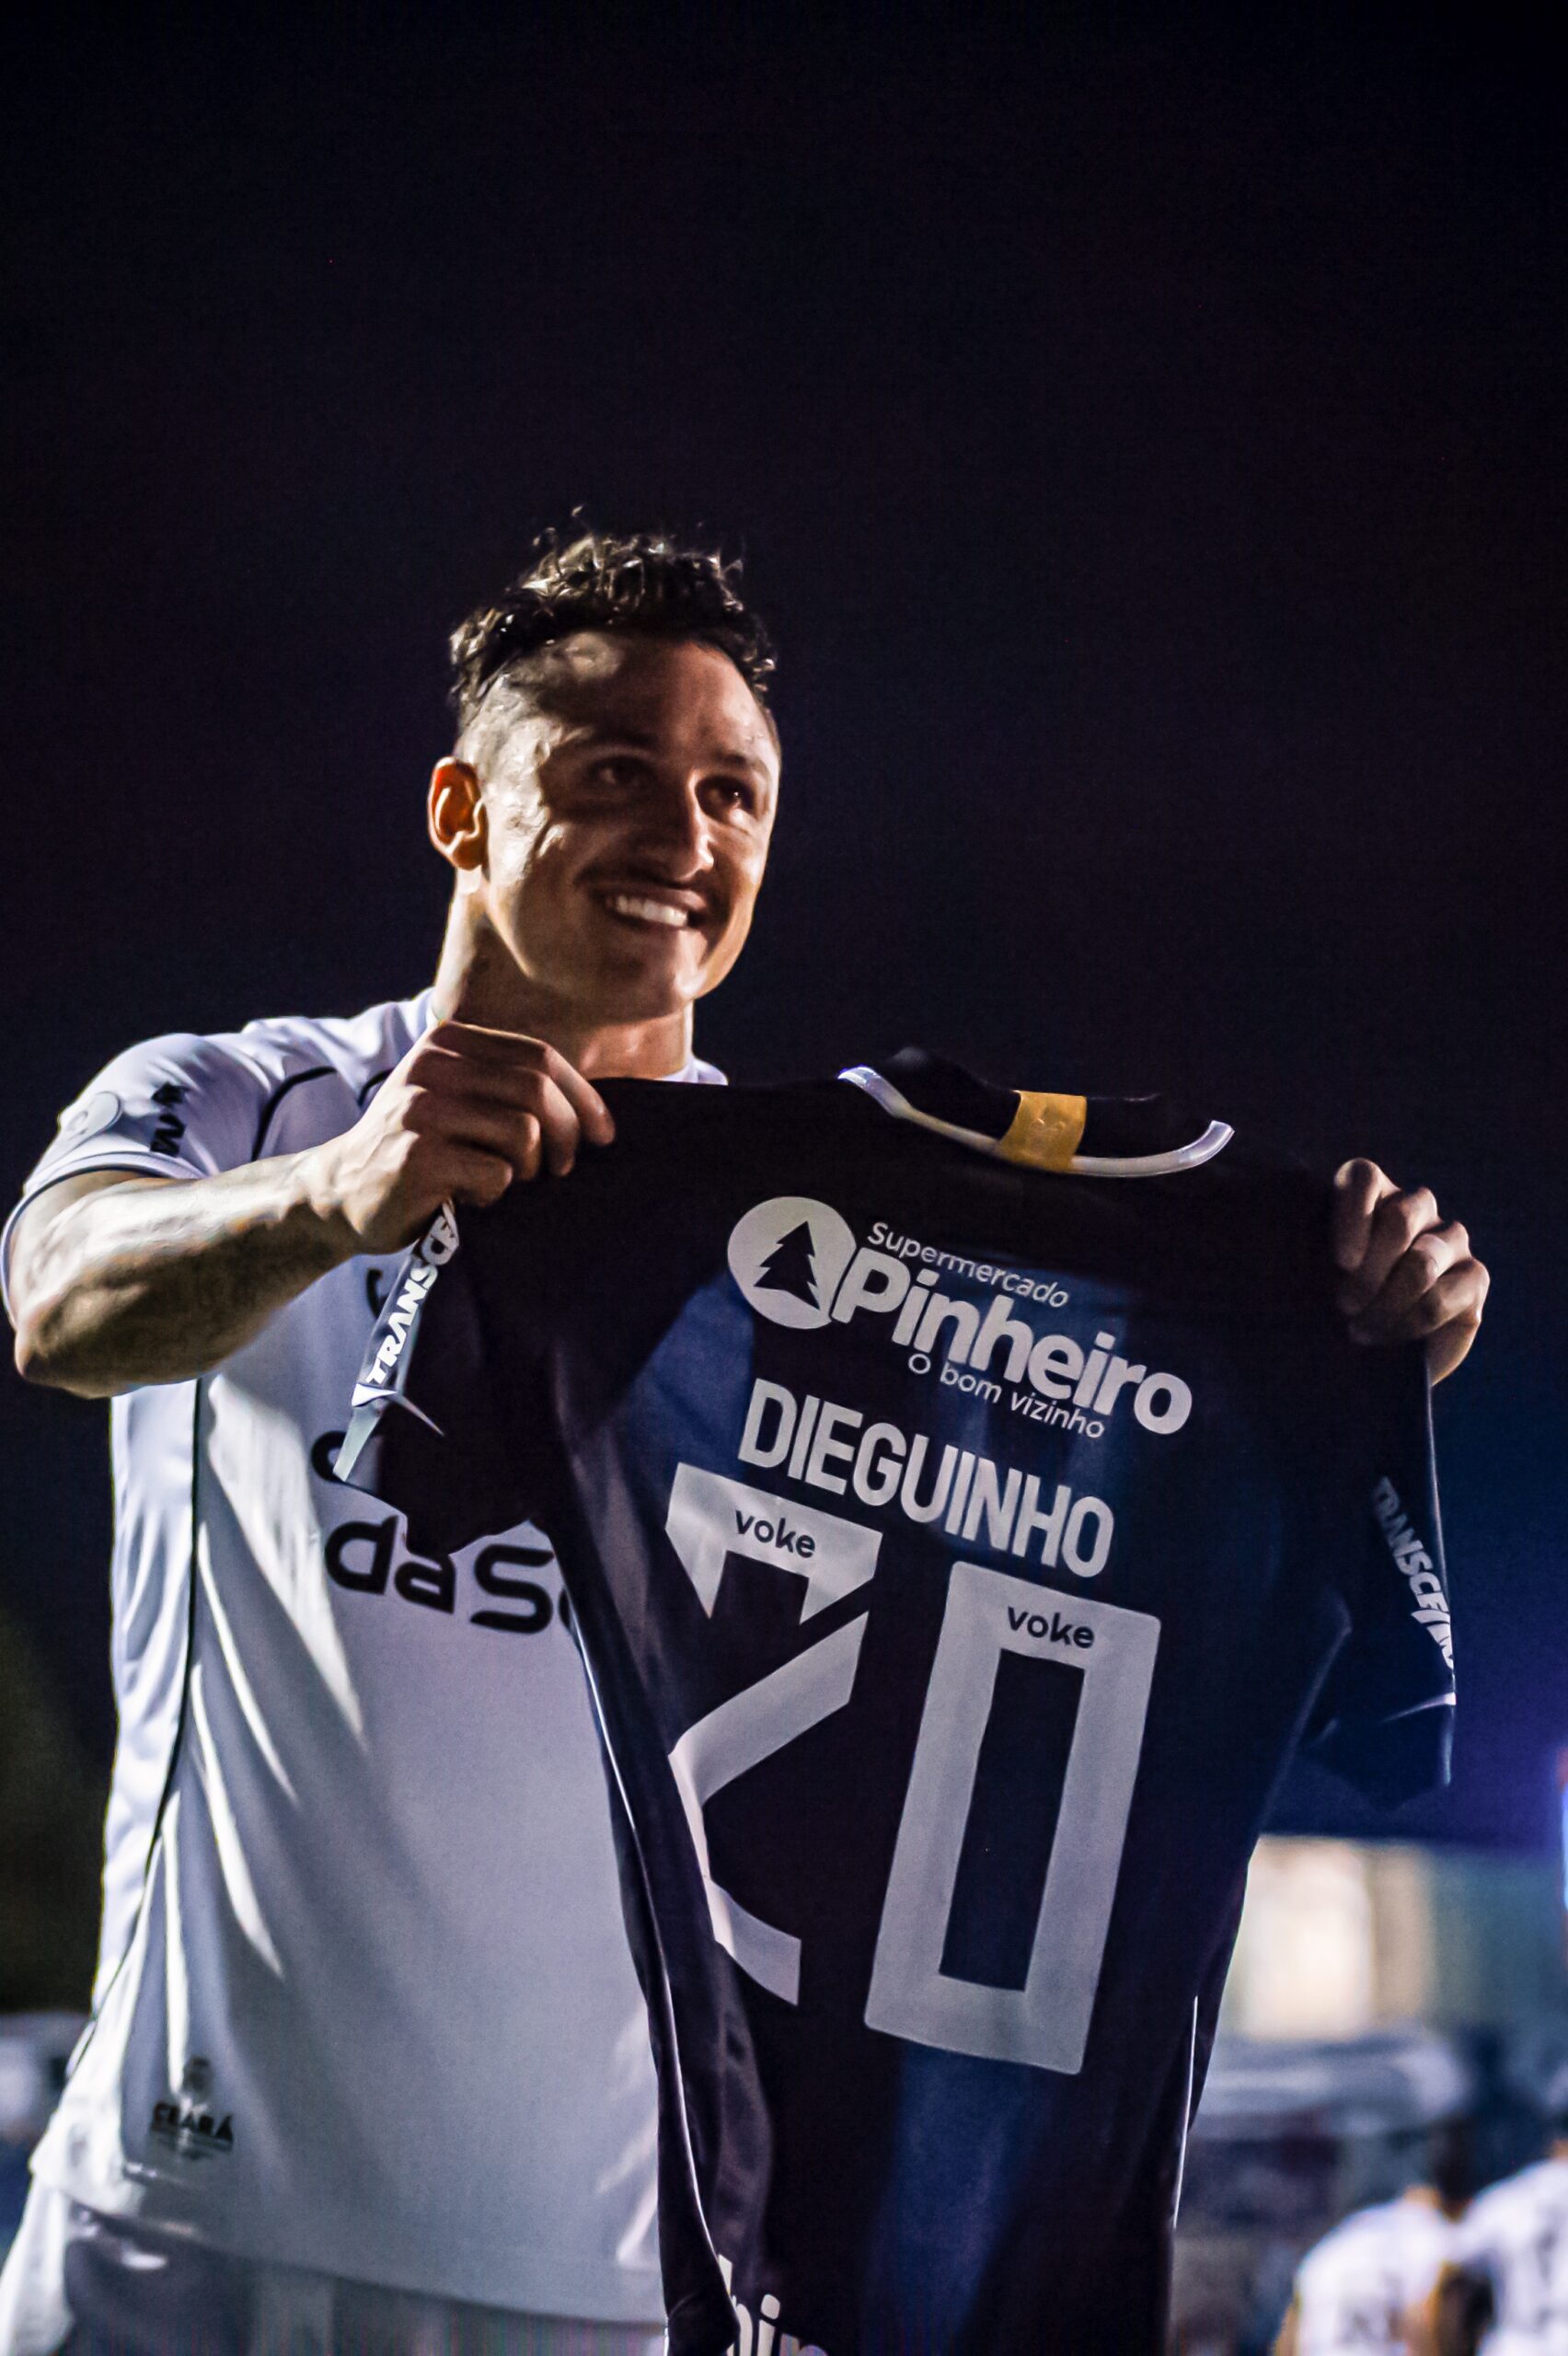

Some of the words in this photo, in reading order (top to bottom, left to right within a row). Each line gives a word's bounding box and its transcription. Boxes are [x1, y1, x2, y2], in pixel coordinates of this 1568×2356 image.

[868, 1221, 1069, 1308] Supermercado
[831, 1247, 1193, 1435] Pinheiro
[907, 1352, 932, 1375] O
[940, 1361, 1002, 1404] bom
[1011, 1391, 1105, 1438] vizinho
[737, 1378, 1115, 1578] DIEGUINHO
[735, 1508, 816, 1559] voke
[1007, 1605, 1095, 1649] voke
